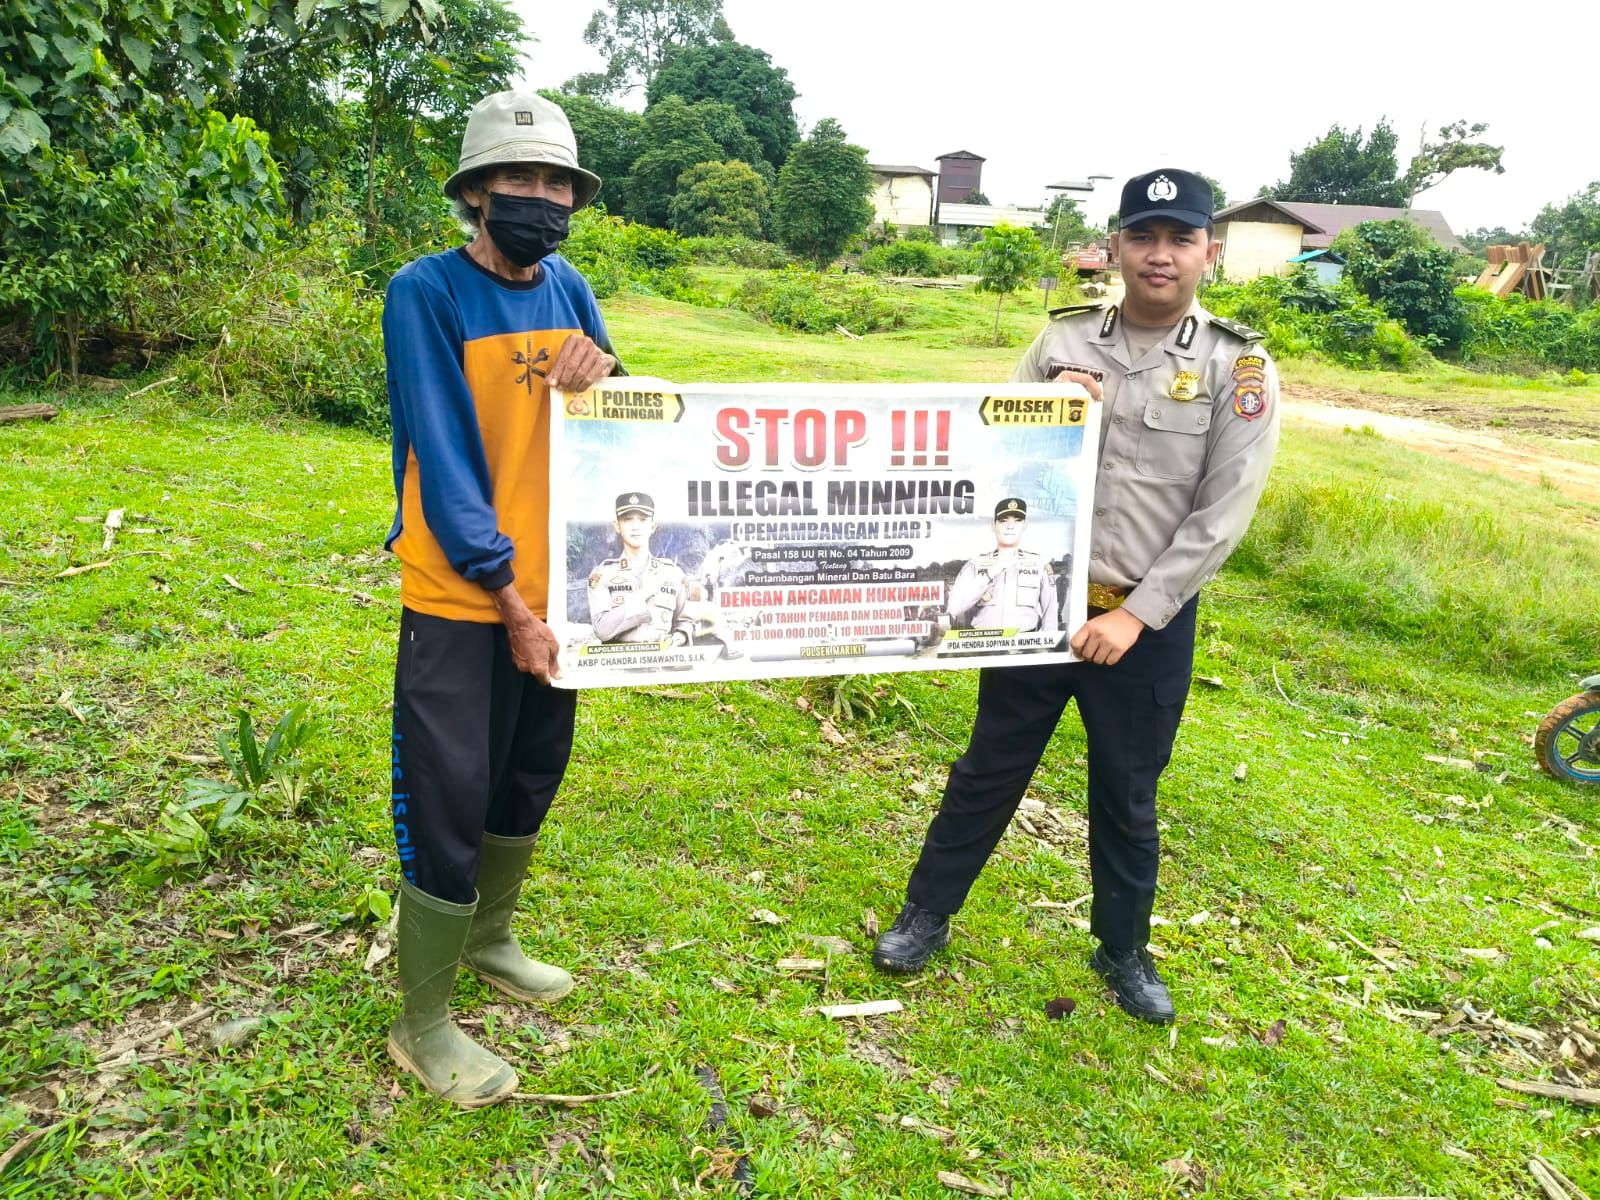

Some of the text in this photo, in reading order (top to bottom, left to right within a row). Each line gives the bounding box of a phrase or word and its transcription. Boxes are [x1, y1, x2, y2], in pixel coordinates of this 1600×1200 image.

[602, 390, 663, 408] POLRES
[993, 399, 1055, 413] POLSEK
[602, 406, 664, 420] KATINGAN
[993, 414, 1053, 423] MARIKIT
[714, 406, 868, 468] STOP
[687, 479, 976, 517] ILLEGAL MINNING
[754, 547, 911, 560] Pasal 158 UU RI No. 04 Tahun 2009
[748, 570, 916, 584] Pertambangan Mineral Dan Batu Bara
[720, 585, 940, 608] DENGAN ANCAMAN HUKUMAN
[775, 610, 807, 624] TAHUN
[809, 608, 849, 622] PENJARA
[851, 609, 871, 620] DAN
[873, 608, 903, 620] DENDA
[853, 624, 887, 636] MILYAR
[801, 643, 866, 657] POLSEK MARIKIT
[947, 641, 960, 650] IPDA
[961, 640, 985, 649] HENDRA
[986, 640, 1010, 648] SOPIYAN
[1043, 637, 1055, 645] S.H.
[577, 659, 599, 668] AKBP
[600, 657, 638, 666] CHANDRA
[639, 655, 686, 664] ISMAWANTO,
